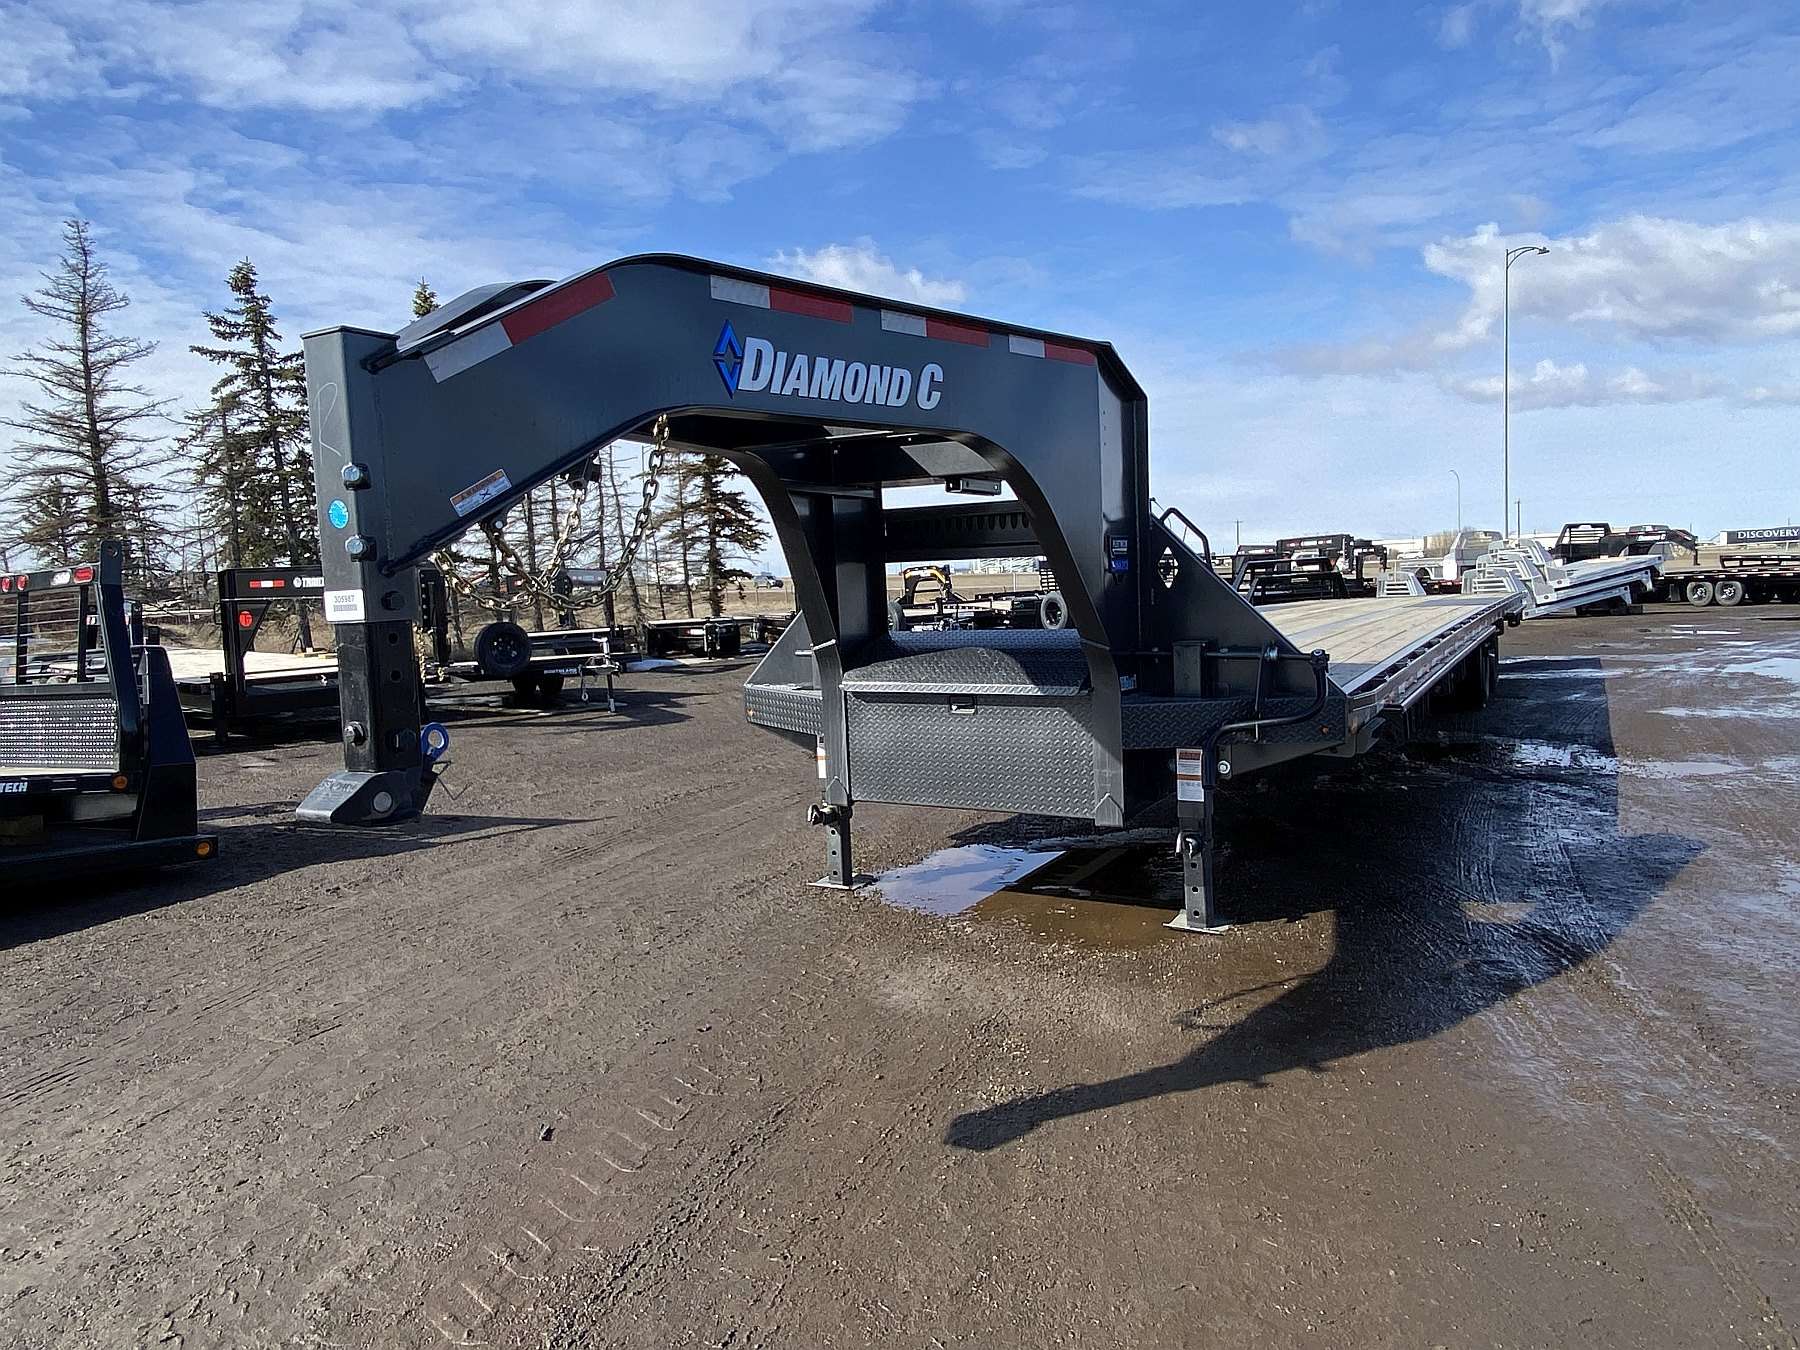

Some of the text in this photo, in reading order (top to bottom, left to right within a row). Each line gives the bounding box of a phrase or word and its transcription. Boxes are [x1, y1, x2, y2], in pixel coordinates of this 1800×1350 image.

[738, 336, 944, 410] DIAMOND C
[1737, 528, 1799, 539] DISCOVERY
